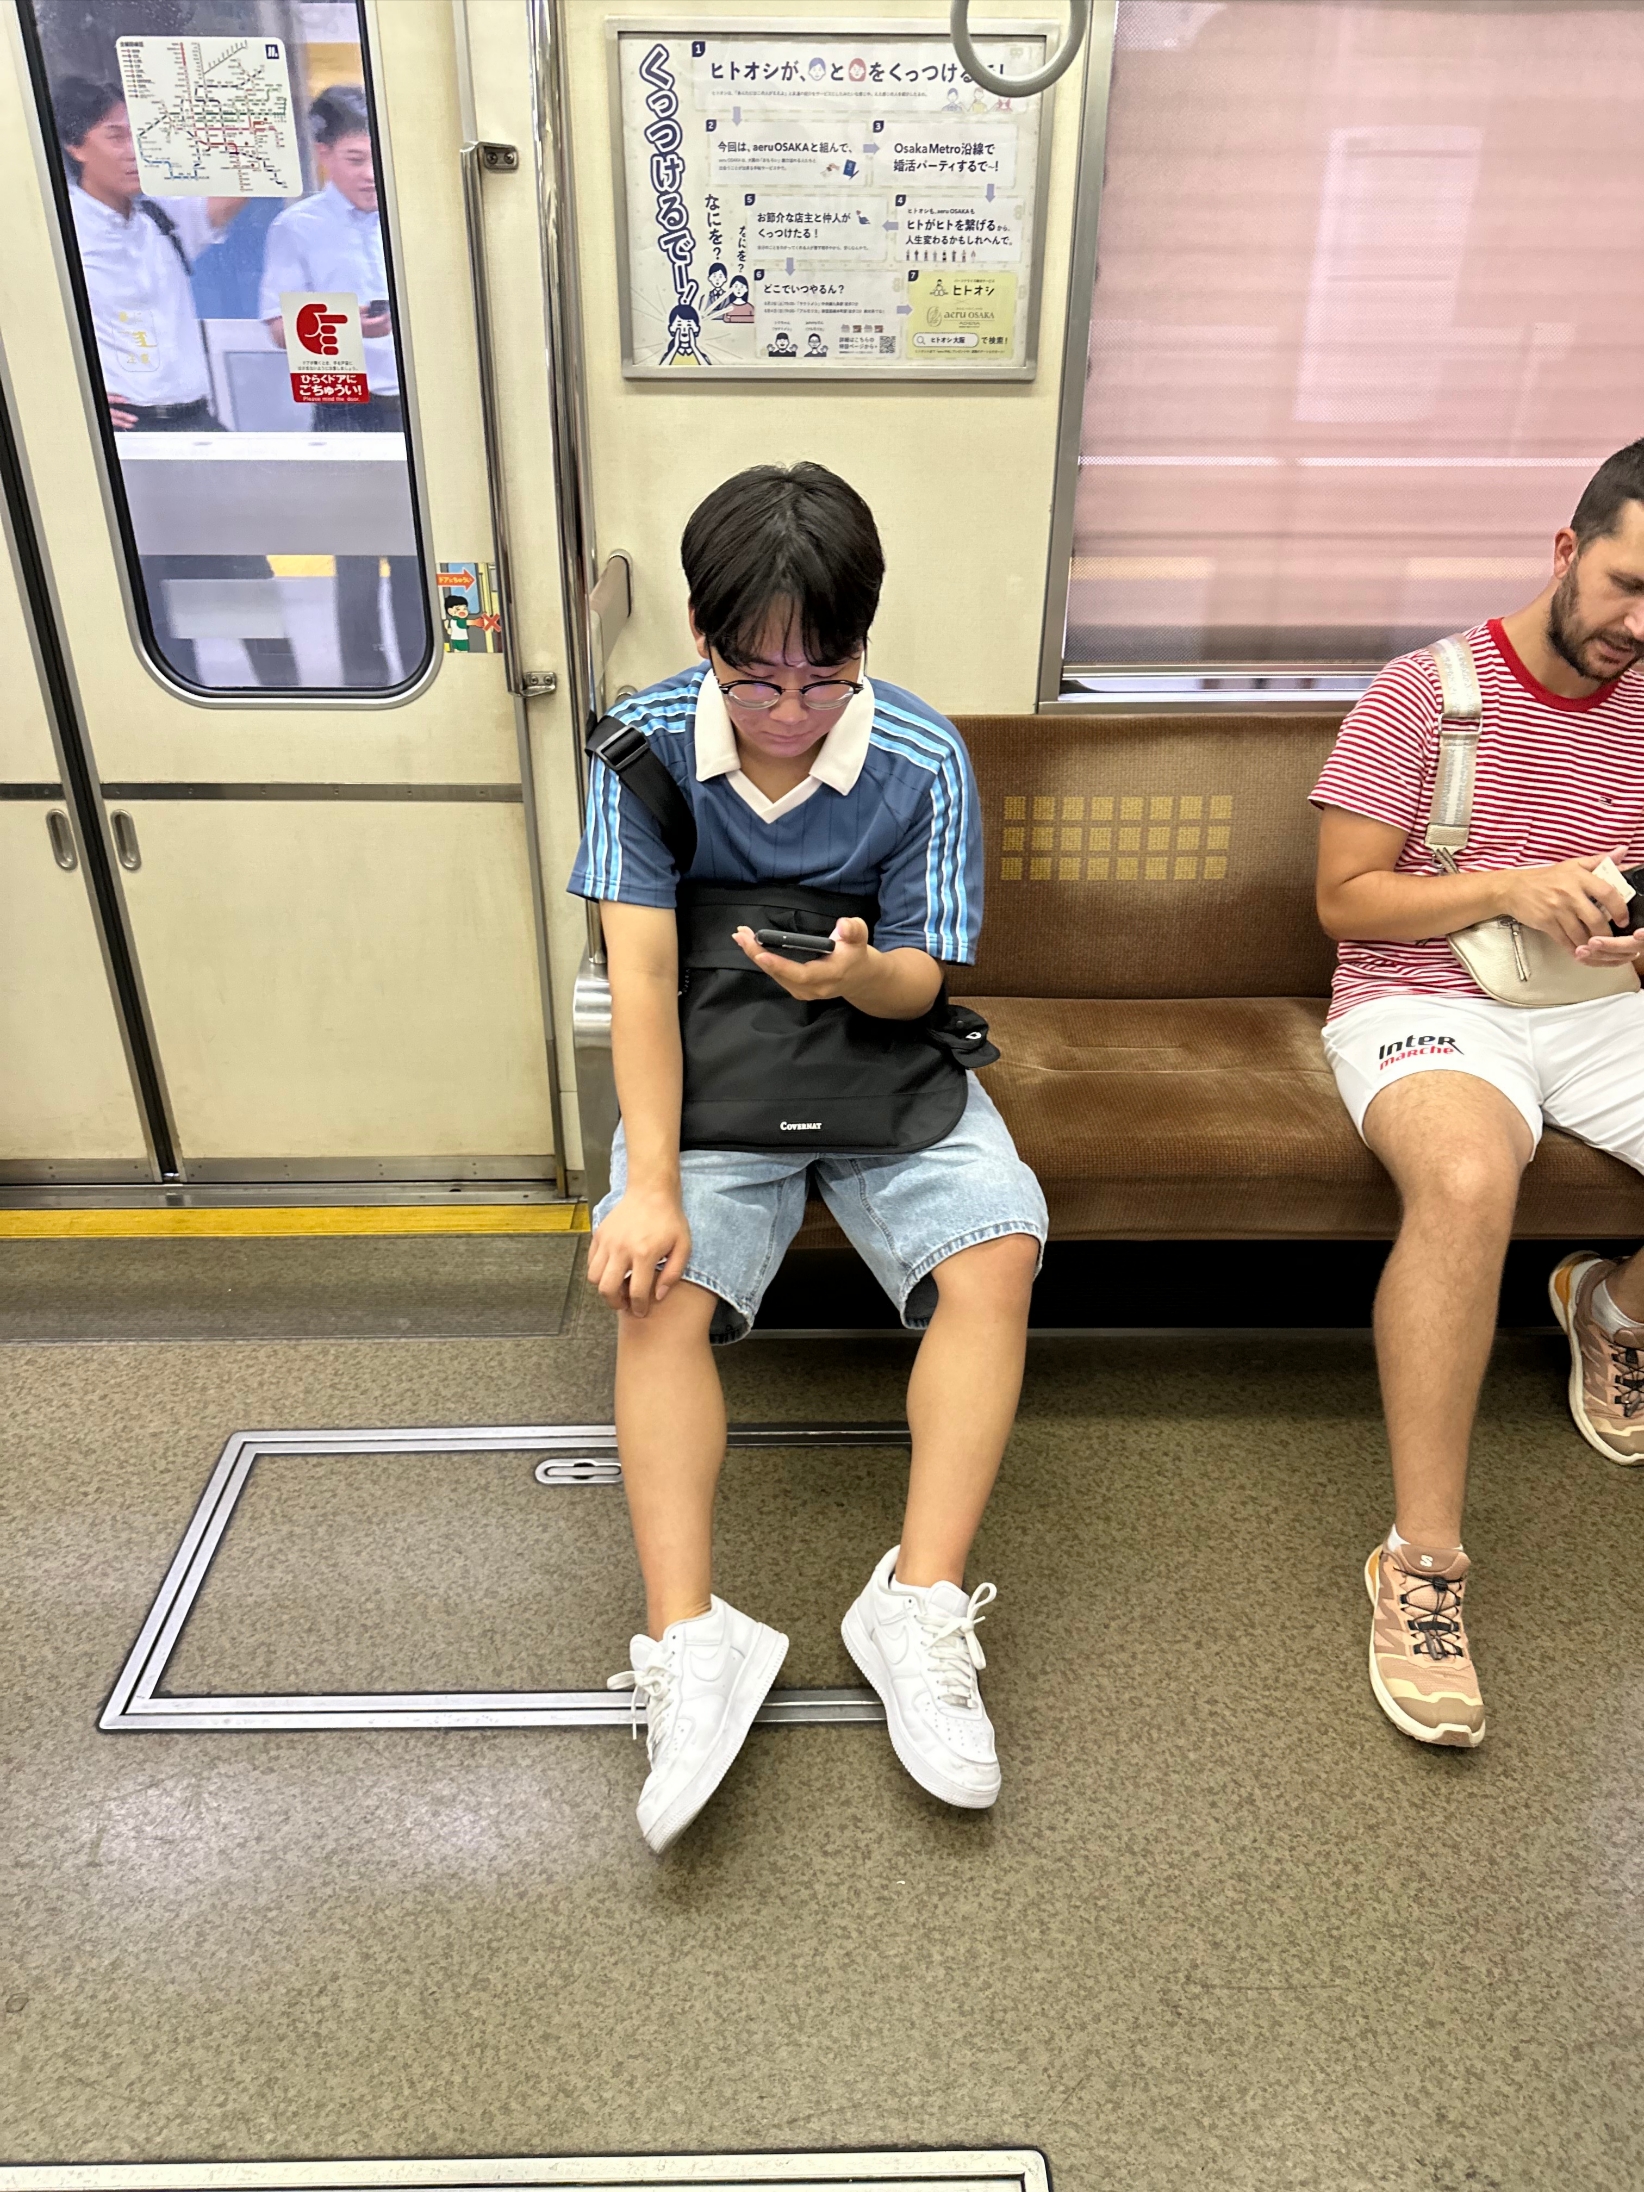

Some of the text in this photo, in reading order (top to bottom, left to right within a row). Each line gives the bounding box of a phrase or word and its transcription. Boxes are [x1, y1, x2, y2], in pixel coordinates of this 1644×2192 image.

[711, 60, 806, 82] ヒトオシが、
[830, 62, 844, 81] と
[757, 212, 851, 223] お節介な店主と仲人が
[704, 193, 723, 260] なにを?
[758, 228, 818, 239] くっつけたる!
[763, 284, 845, 294] どこでいつやるん?
[953, 285, 995, 296] ヒトオシ
[943, 311, 995, 319] aeru OSAKA
[300, 374, 357, 384] ひらくドアに
[299, 384, 362, 396] ごちゅうい!
